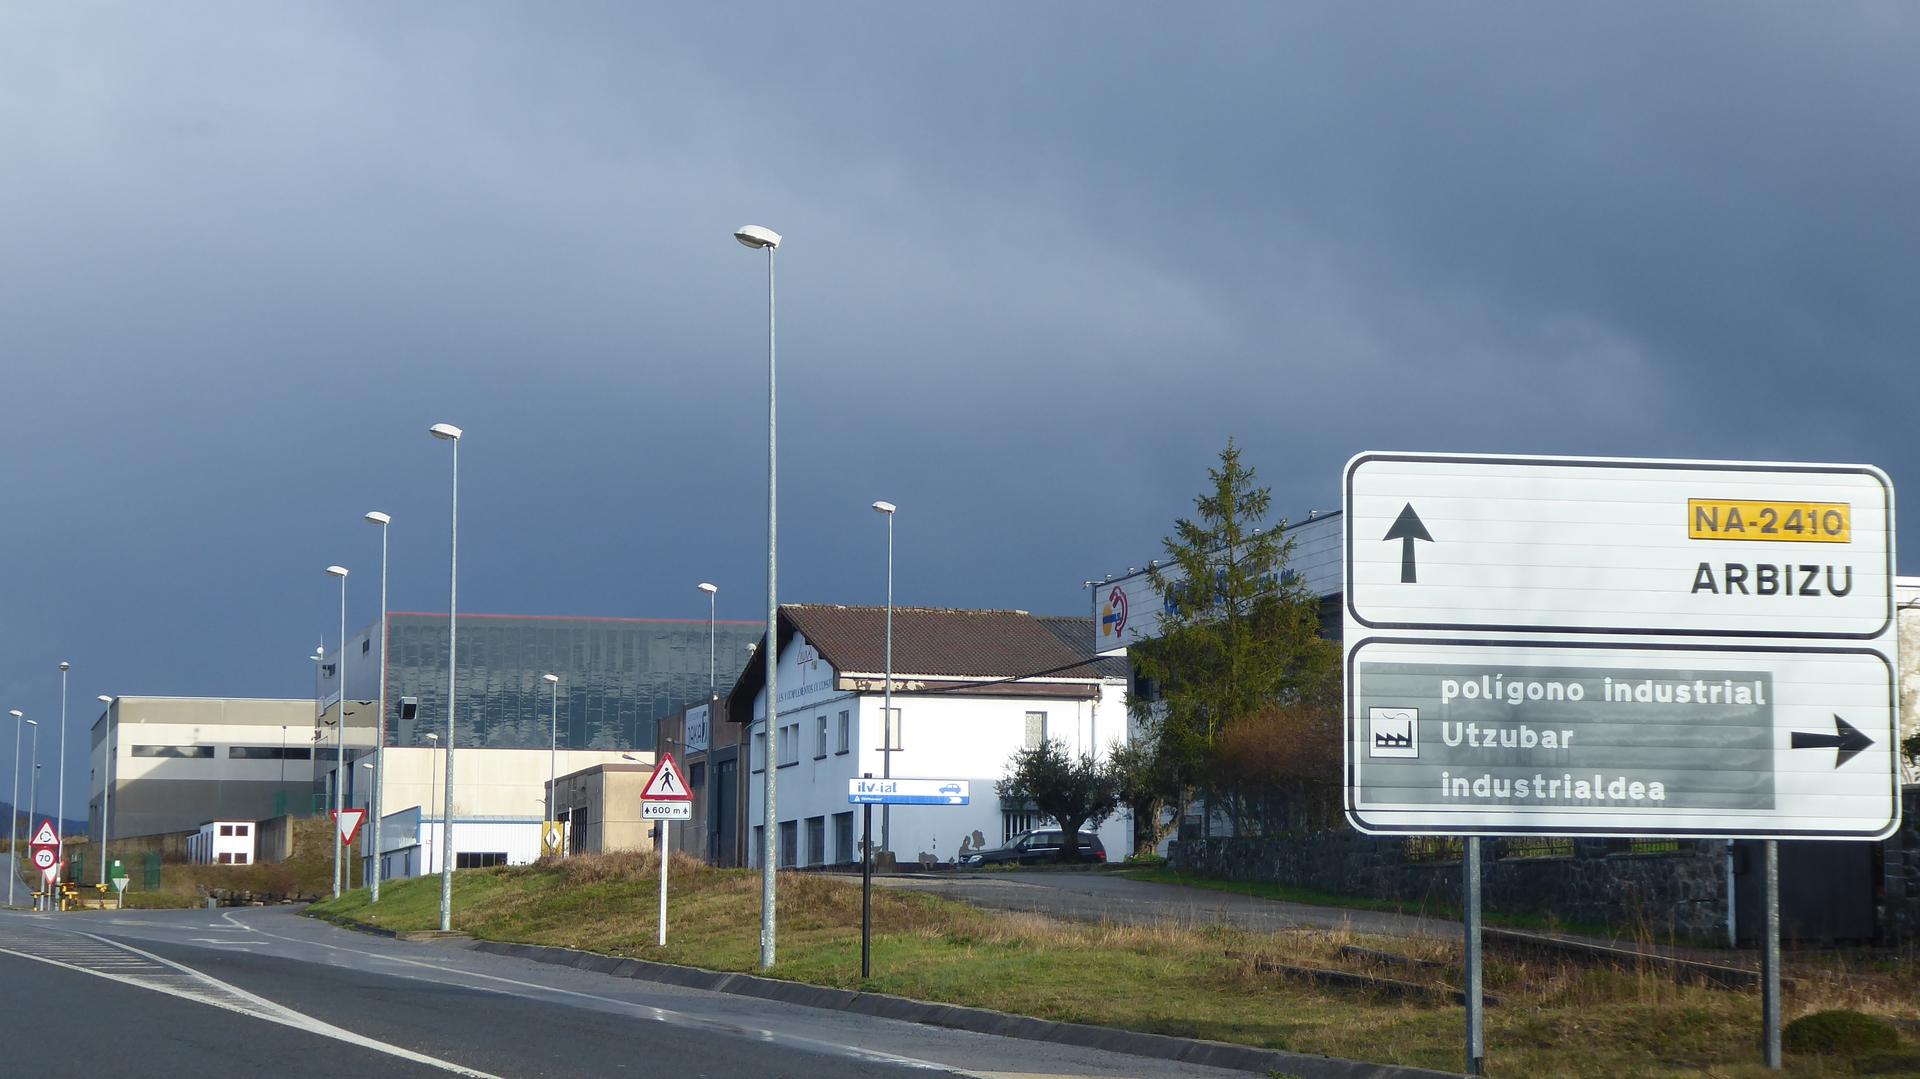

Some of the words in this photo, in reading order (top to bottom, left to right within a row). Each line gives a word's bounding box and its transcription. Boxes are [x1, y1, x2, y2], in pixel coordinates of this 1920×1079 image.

[1695, 506, 1844, 535] NA-2410
[1691, 562, 1853, 597] ARBIZU
[1441, 674, 1585, 705] polígono
[1604, 677, 1767, 705] industrial
[1442, 722, 1574, 748] Utzubar
[1442, 772, 1666, 800] industrialdea
[652, 806, 671, 814] 600
[39, 854, 51, 862] 70
